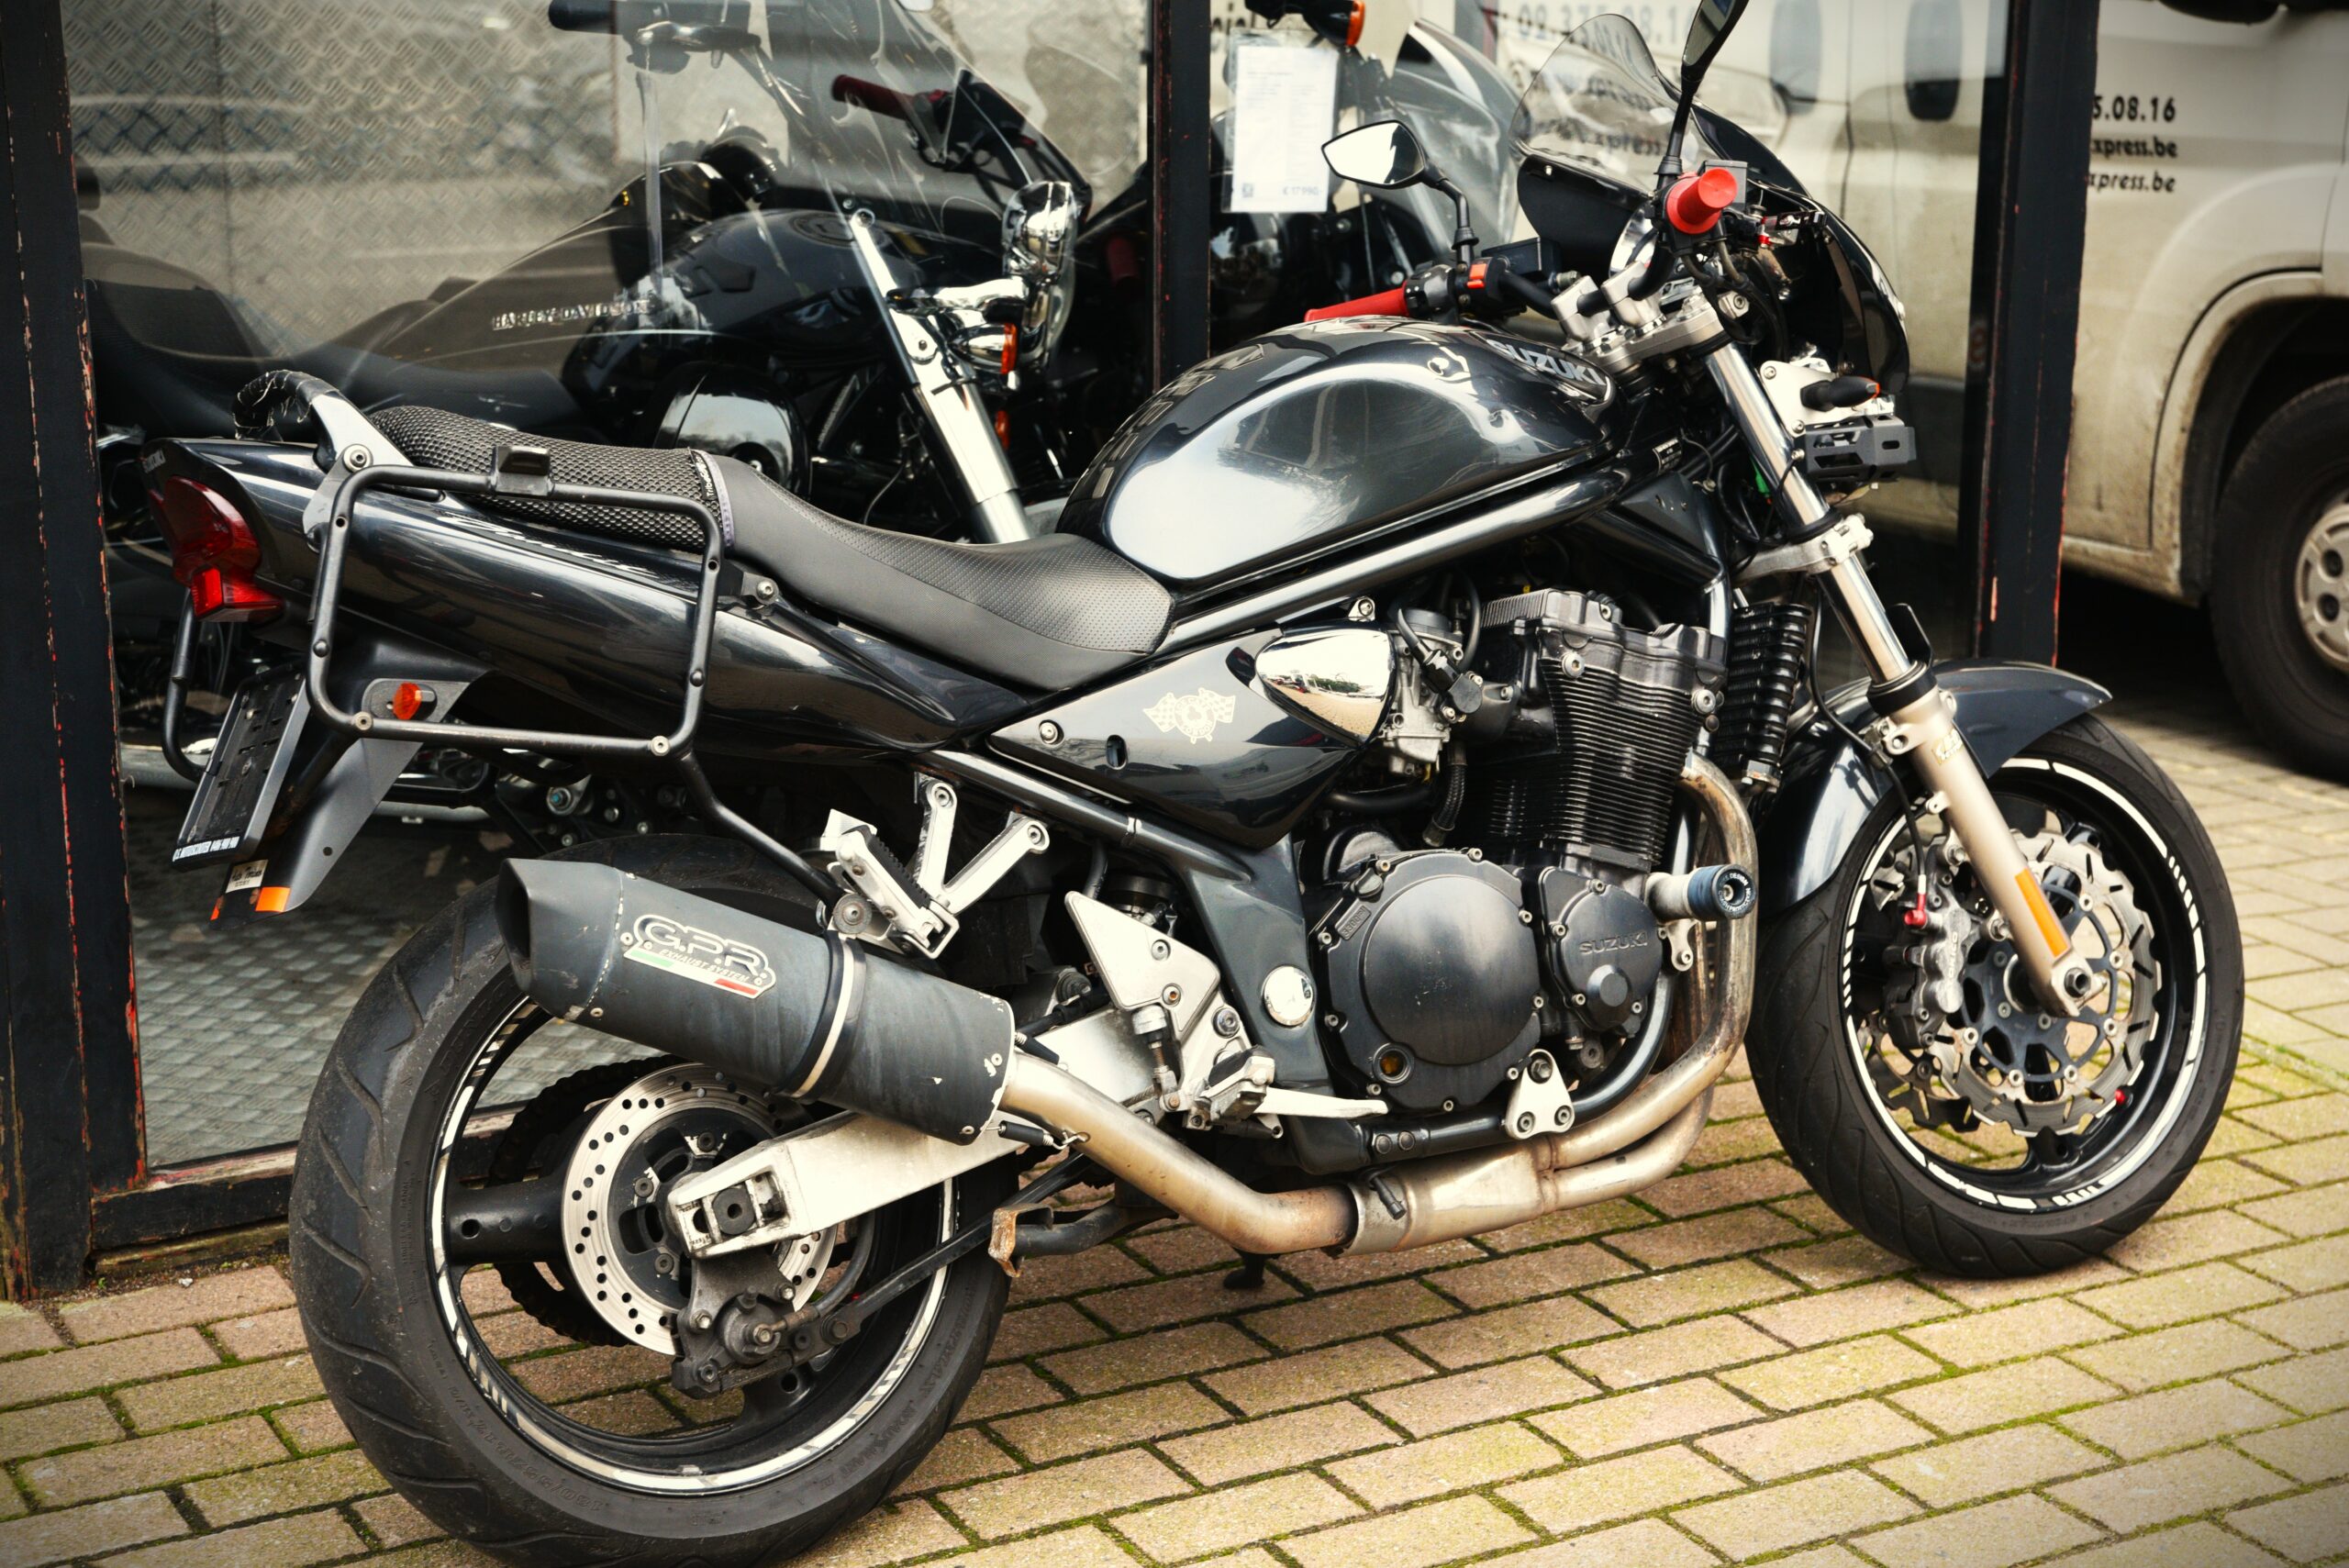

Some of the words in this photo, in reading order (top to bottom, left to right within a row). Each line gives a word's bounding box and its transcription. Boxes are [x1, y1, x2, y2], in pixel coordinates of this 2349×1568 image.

[1486, 339, 1607, 385] SUZUKI
[1578, 931, 1649, 955] SUZUKI
[658, 947, 708, 971] EXHAUST
[706, 963, 750, 984] SYSTEM
